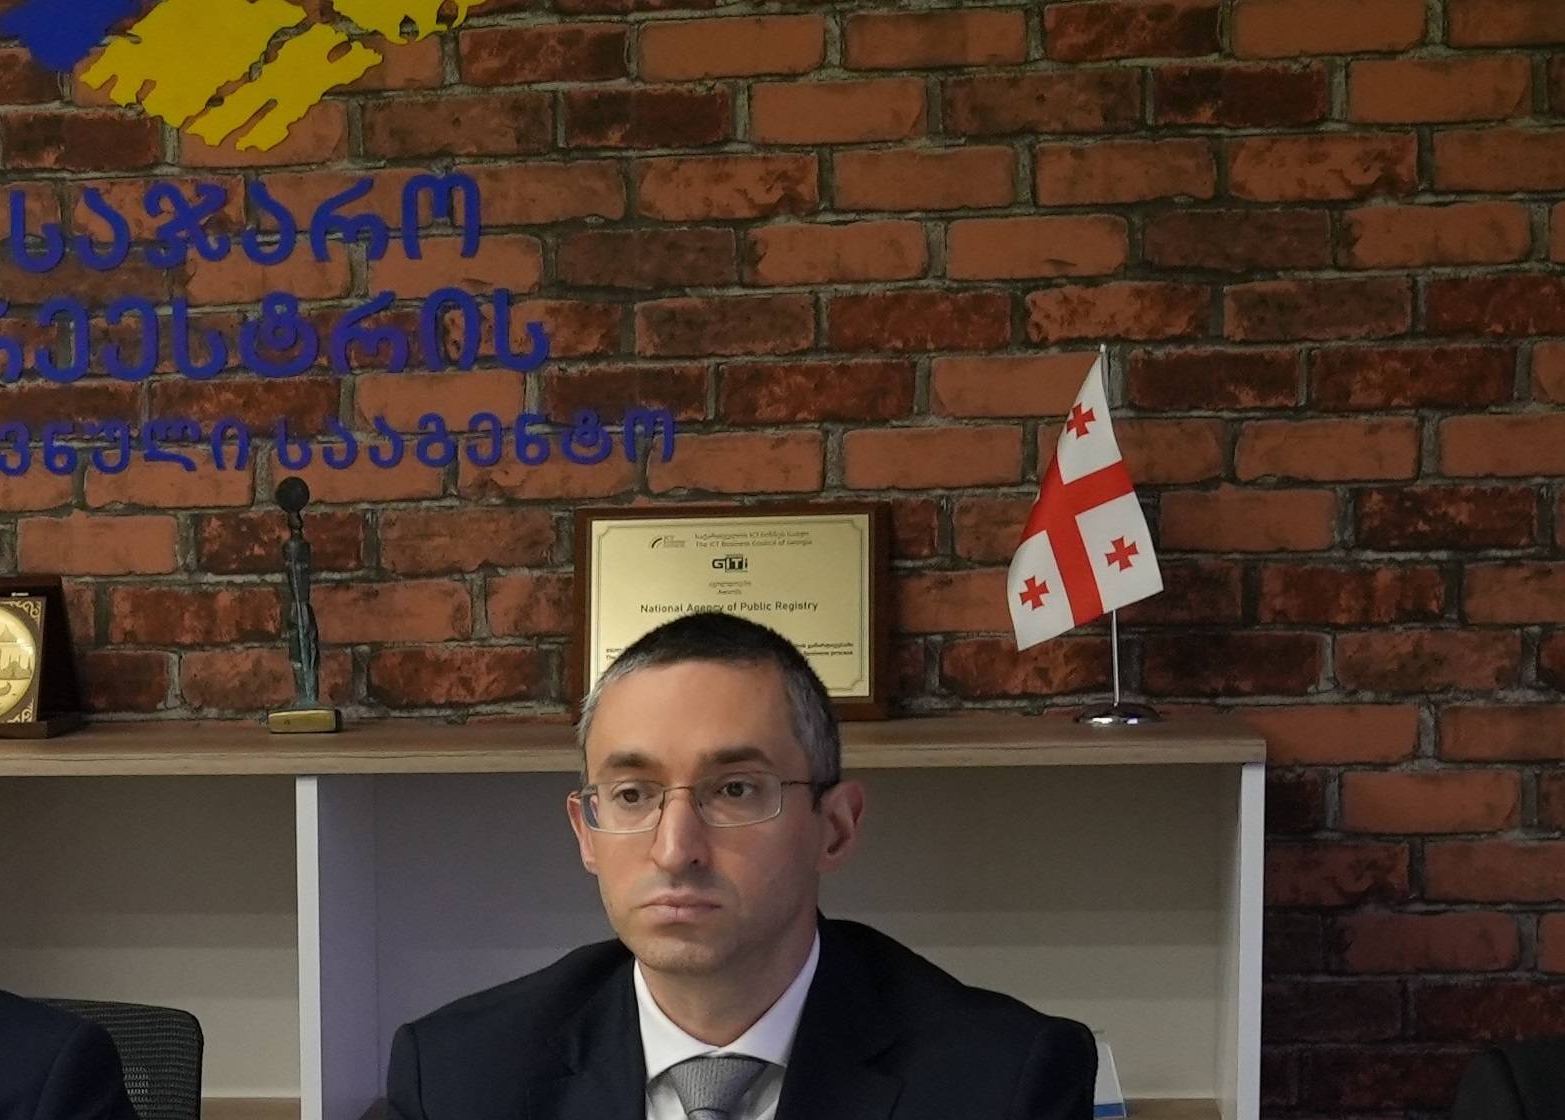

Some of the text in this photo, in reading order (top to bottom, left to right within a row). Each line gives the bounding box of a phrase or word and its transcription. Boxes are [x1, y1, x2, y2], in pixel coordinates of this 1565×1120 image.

[7, 172, 483, 273] საჯარო
[274, 408, 678, 469] სააგენტო
[640, 603, 683, 613] National
[727, 602, 737, 611] of
[740, 601, 771, 612] Public
[775, 600, 819, 612] Registry
